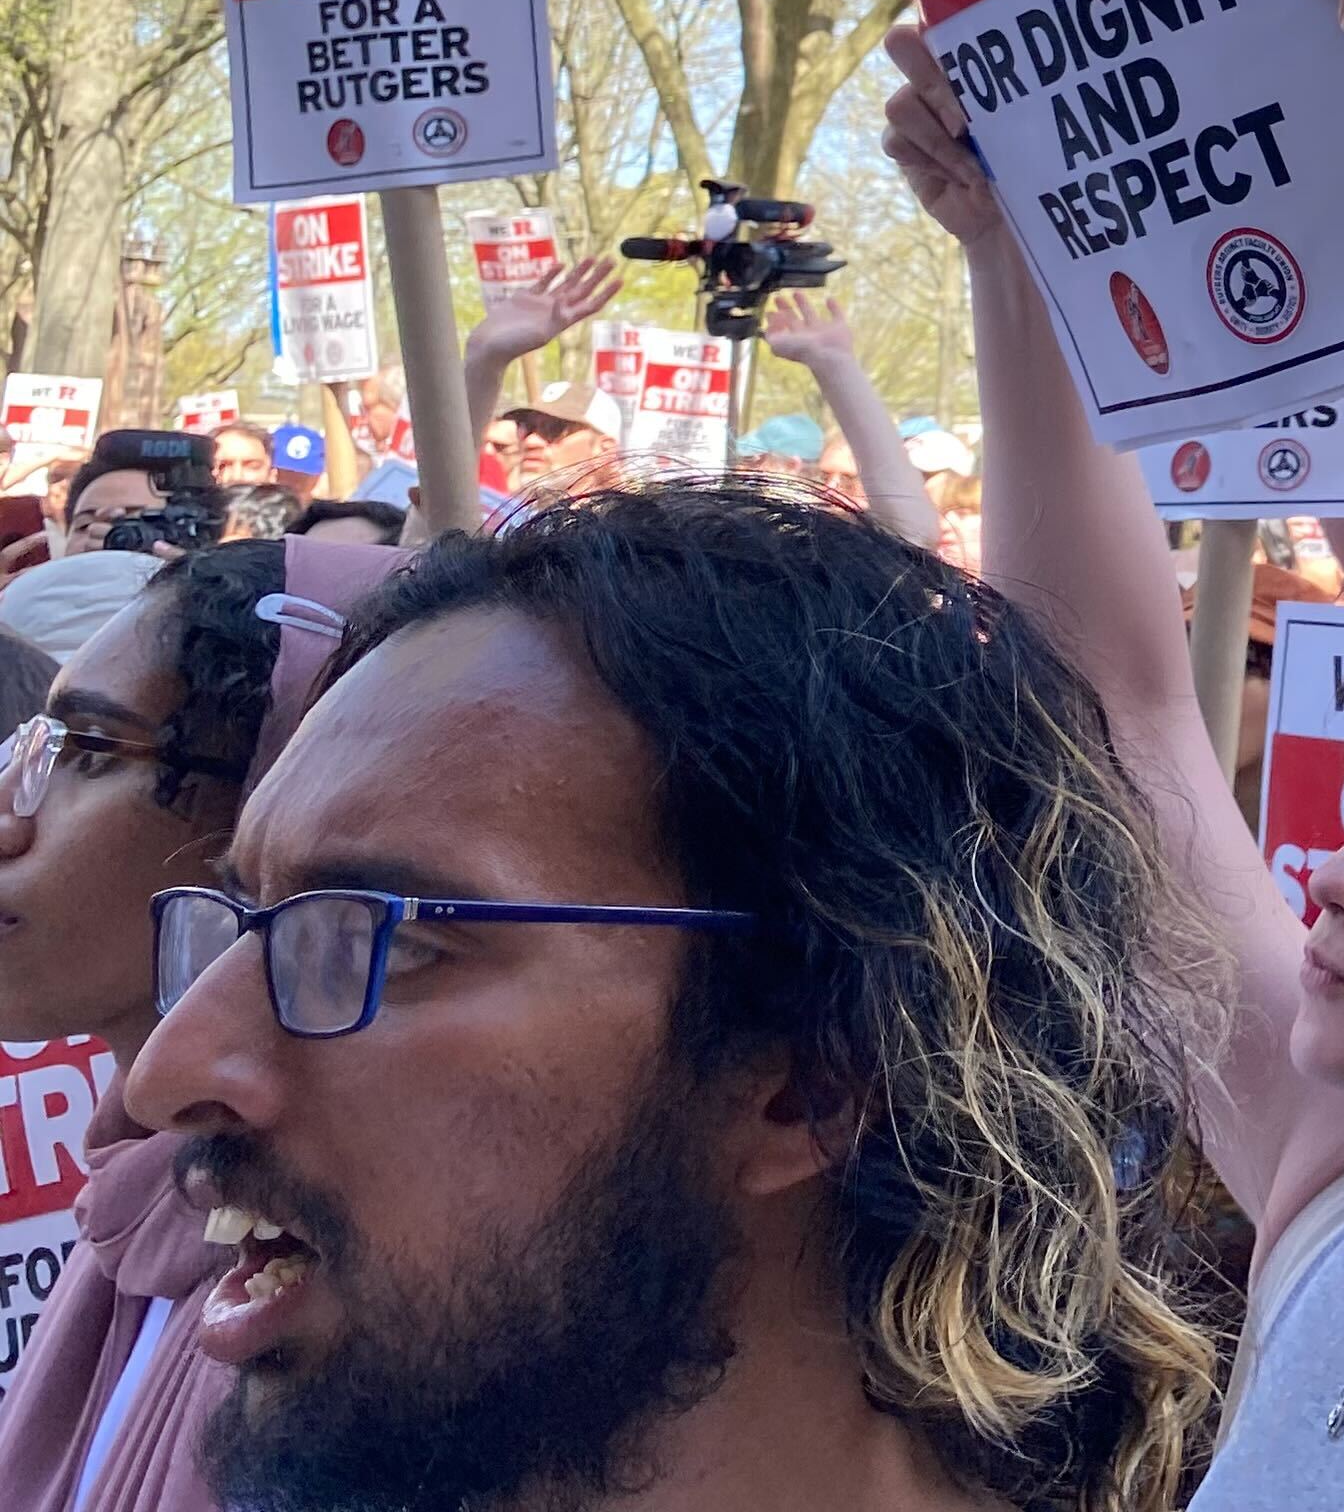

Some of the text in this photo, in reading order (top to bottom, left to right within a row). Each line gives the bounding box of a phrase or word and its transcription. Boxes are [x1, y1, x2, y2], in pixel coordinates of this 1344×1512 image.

[306, 26, 472, 74] BETTER
[937, 28, 1030, 123] FOR
[296, 62, 491, 114] RUTGERS
[1051, 56, 1181, 171] AND
[1038, 101, 1292, 261] RESPECT
[293, 211, 330, 246] ON
[278, 241, 362, 283] STRIKE
